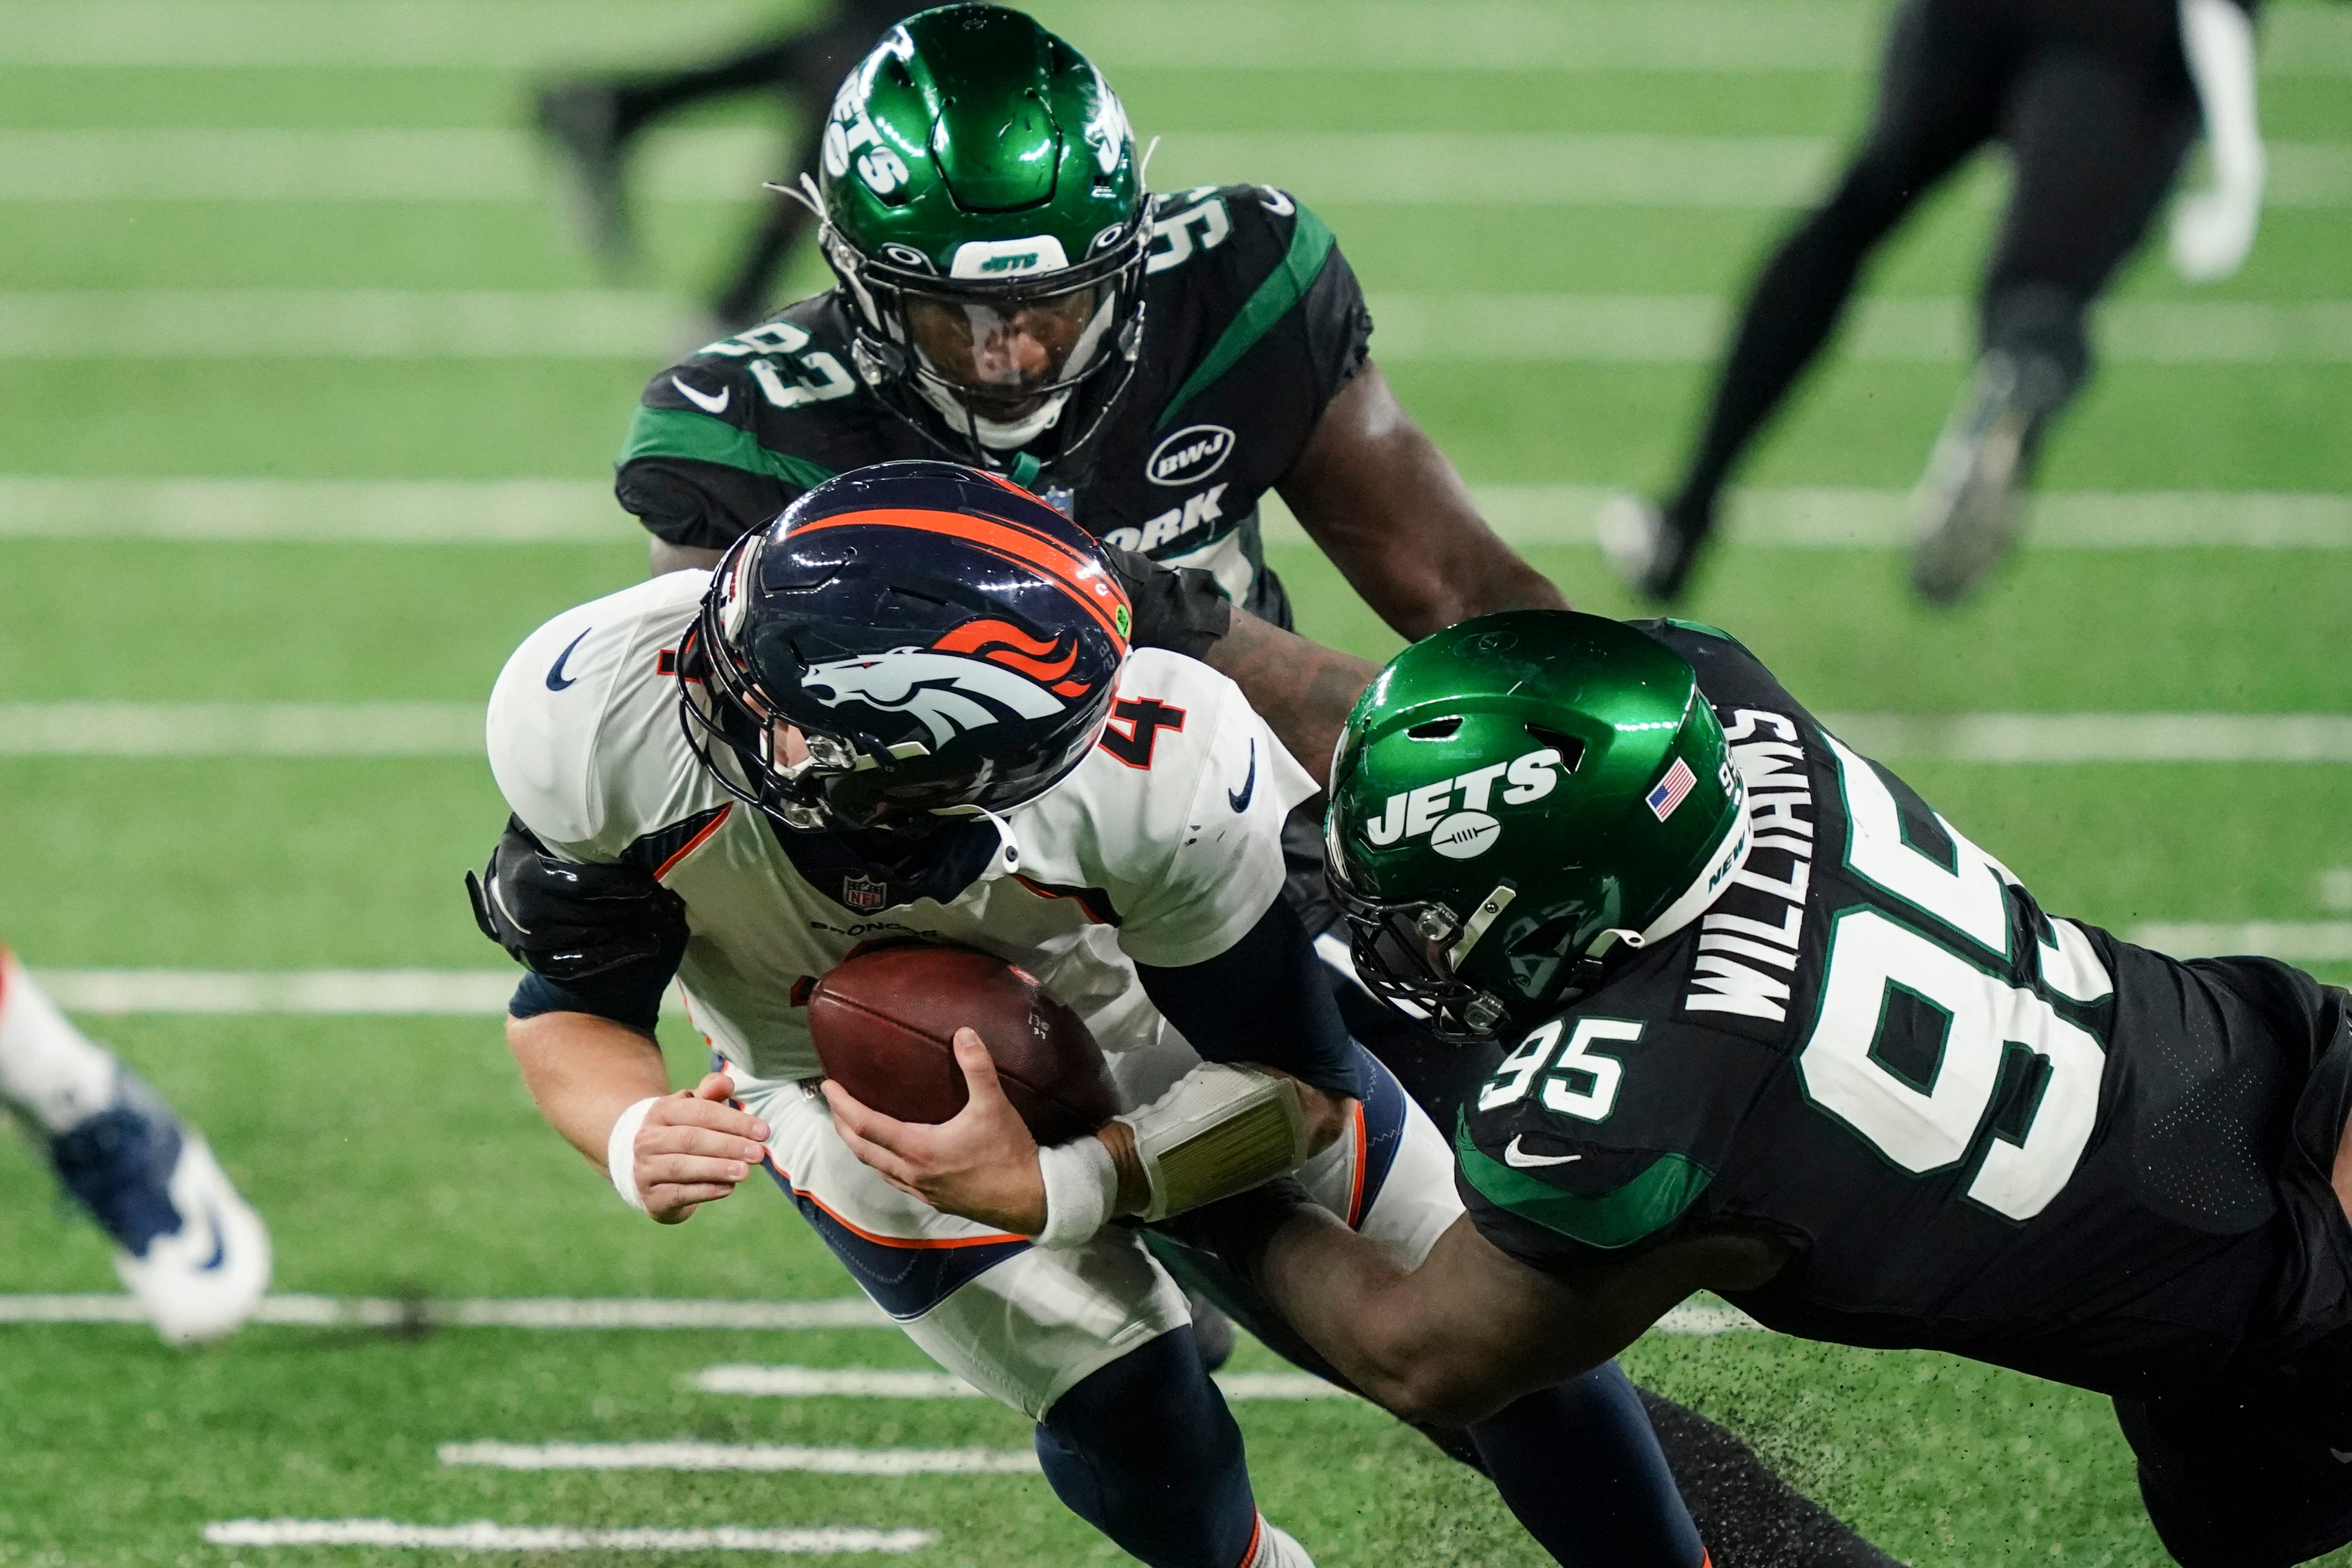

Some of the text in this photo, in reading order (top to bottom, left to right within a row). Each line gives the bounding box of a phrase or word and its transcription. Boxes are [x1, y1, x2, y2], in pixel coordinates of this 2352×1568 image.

[1145, 185, 1230, 275] 9
[1157, 435, 1225, 479] BWJ
[1103, 482, 1229, 554] ORK
[1097, 695, 1187, 771] 4
[1366, 748, 1562, 847] JETS
[848, 890, 882, 907] NFL
[1684, 709, 1813, 1022] WILLIAMS
[1708, 828, 1746, 894] NEW
[1798, 730, 2115, 1221] 95
[1477, 1018, 1648, 1124] 95
